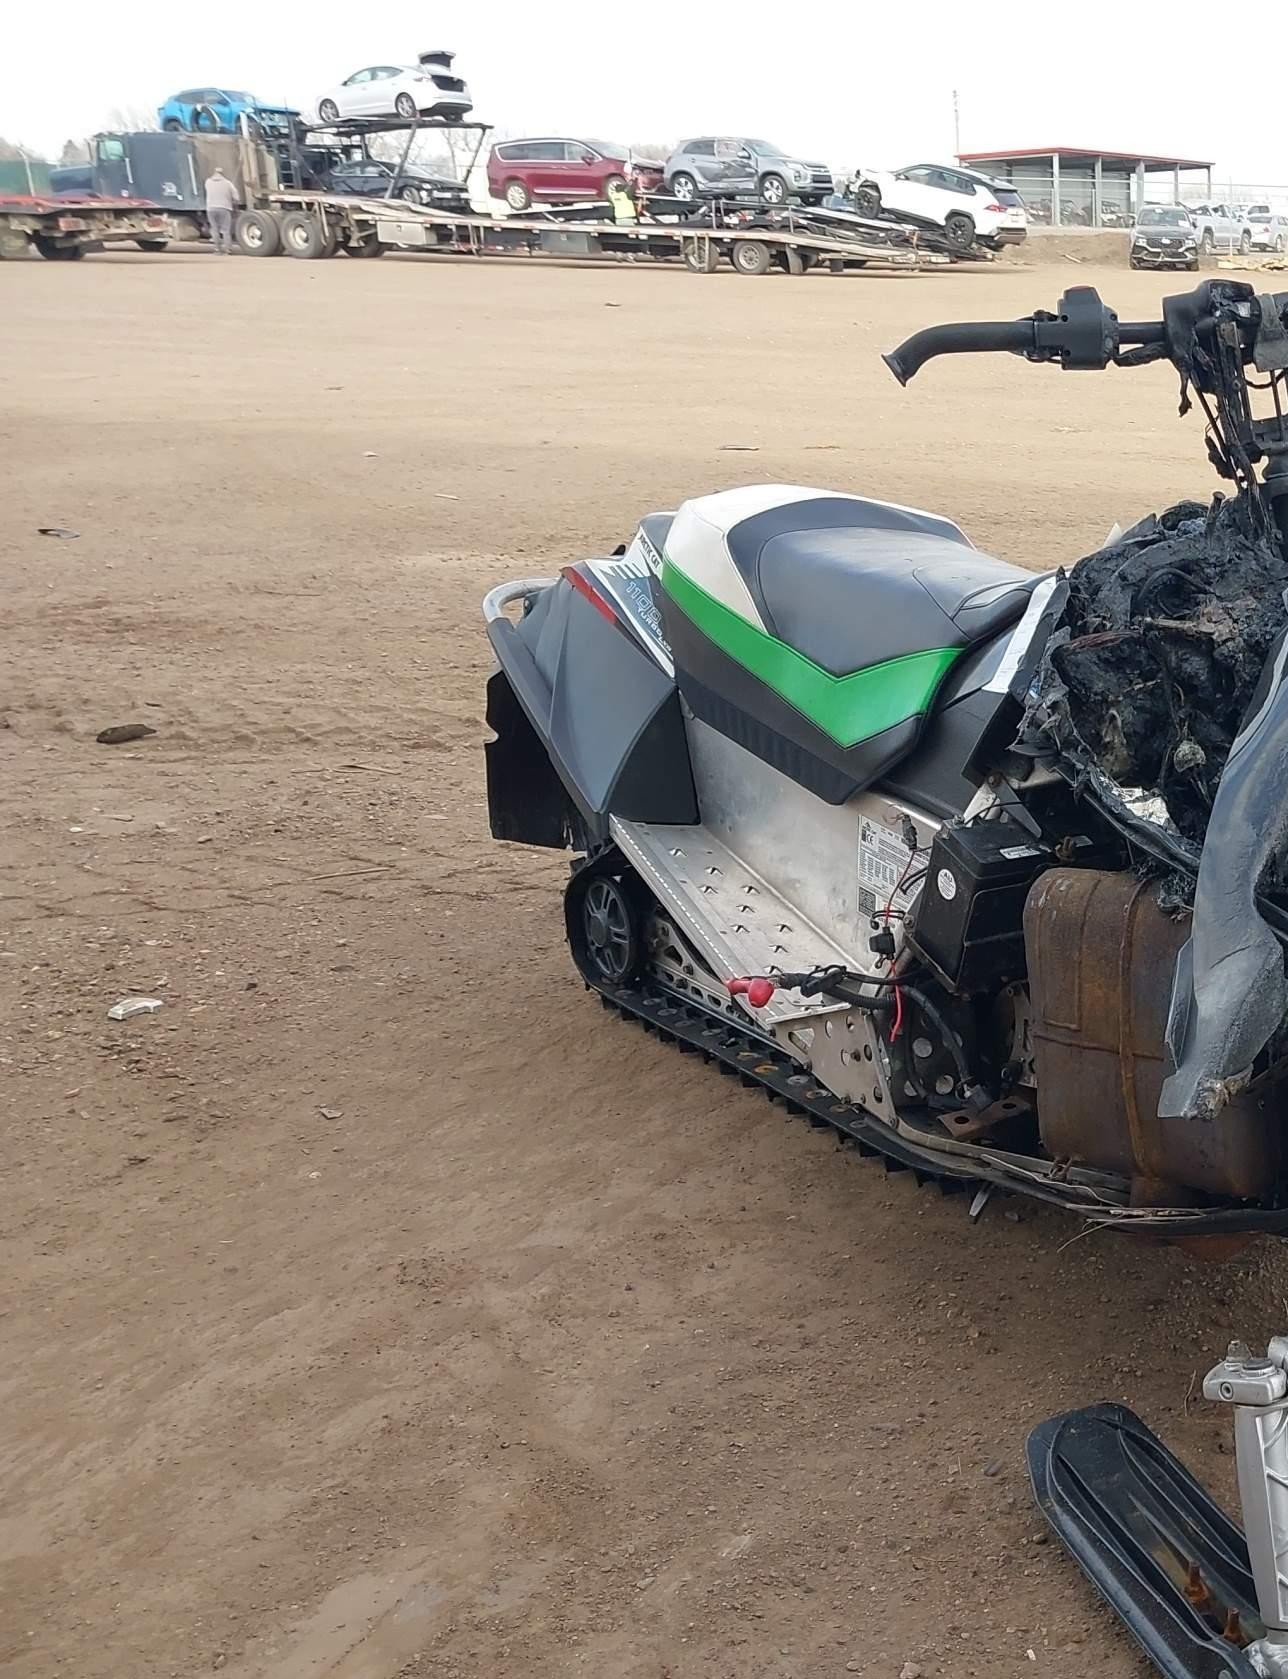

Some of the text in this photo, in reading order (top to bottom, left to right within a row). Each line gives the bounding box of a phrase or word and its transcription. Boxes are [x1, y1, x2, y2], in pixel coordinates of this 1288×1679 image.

[650, 554, 661, 569] CAT
[626, 581, 662, 625] 1100
[637, 607, 663, 636] TURBO
